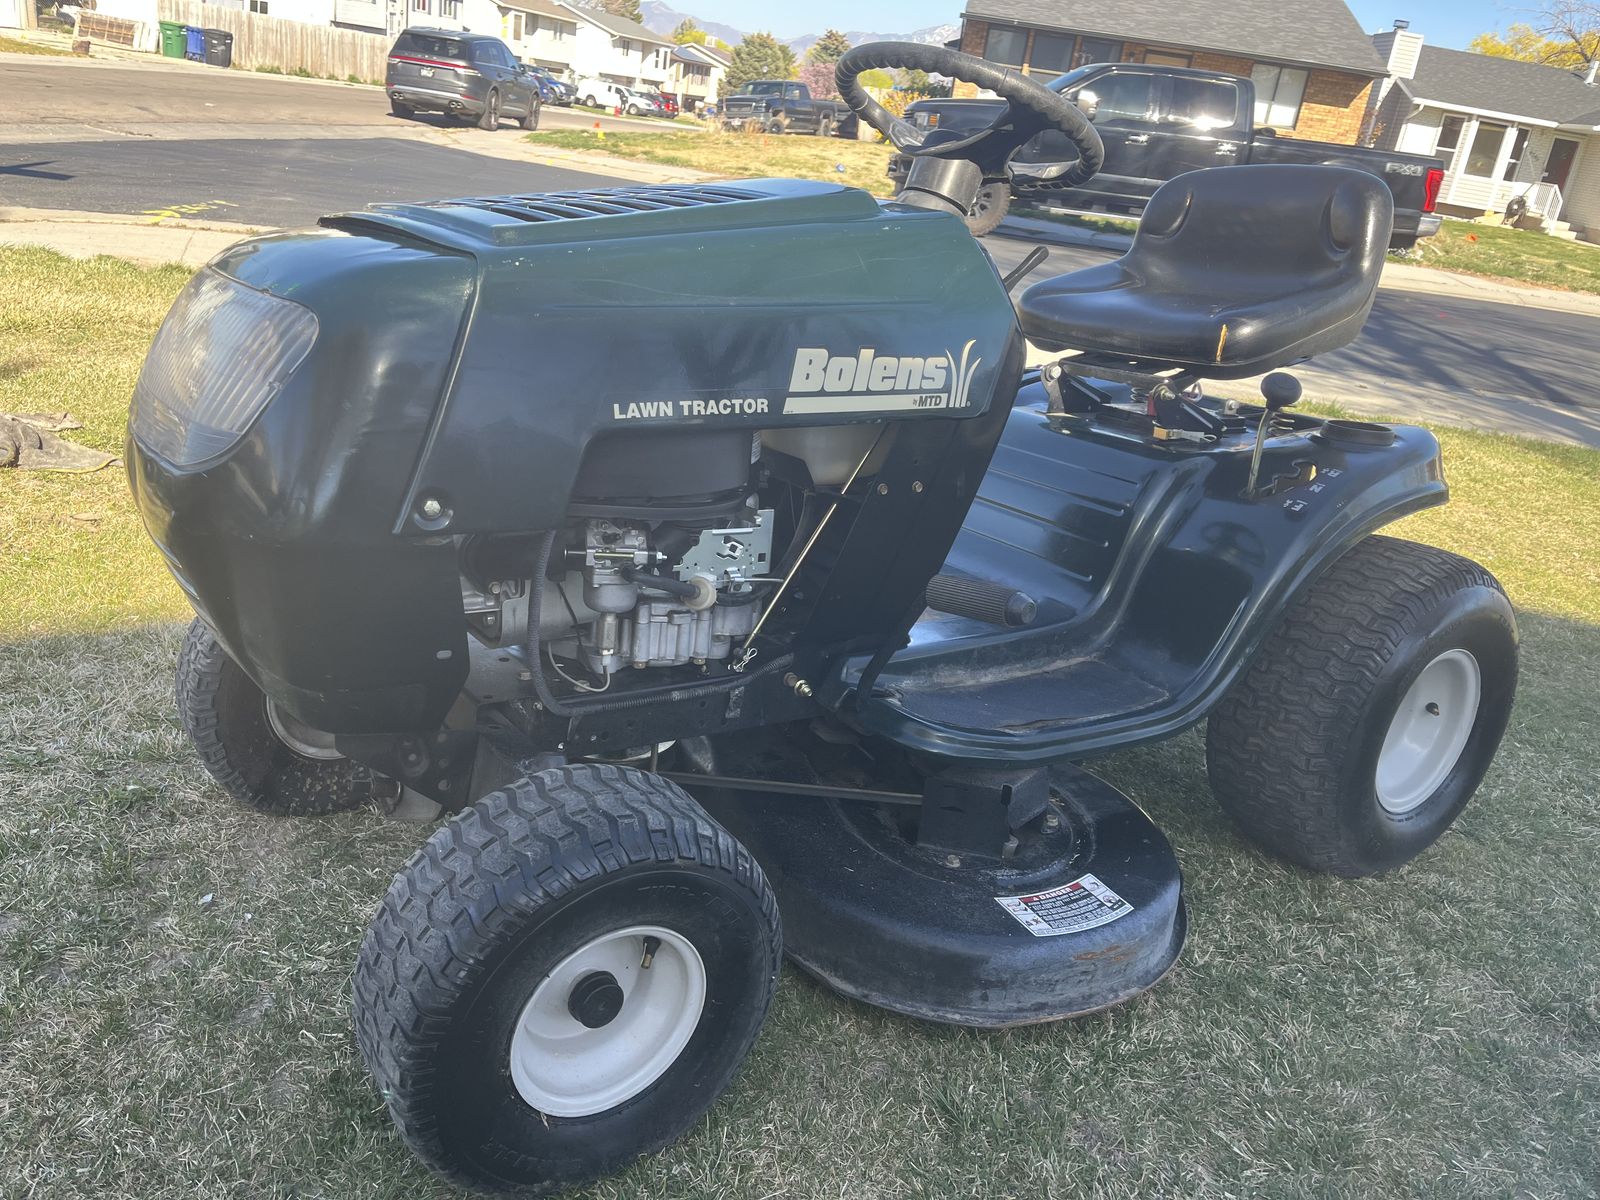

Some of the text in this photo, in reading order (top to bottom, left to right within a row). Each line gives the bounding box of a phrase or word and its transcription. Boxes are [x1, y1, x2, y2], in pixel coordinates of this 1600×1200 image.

[788, 348, 948, 392] Bolens
[613, 398, 769, 419] LAWN TRACTOR
[918, 395, 942, 408] MTD
[1040, 887, 1073, 900] DANGER
